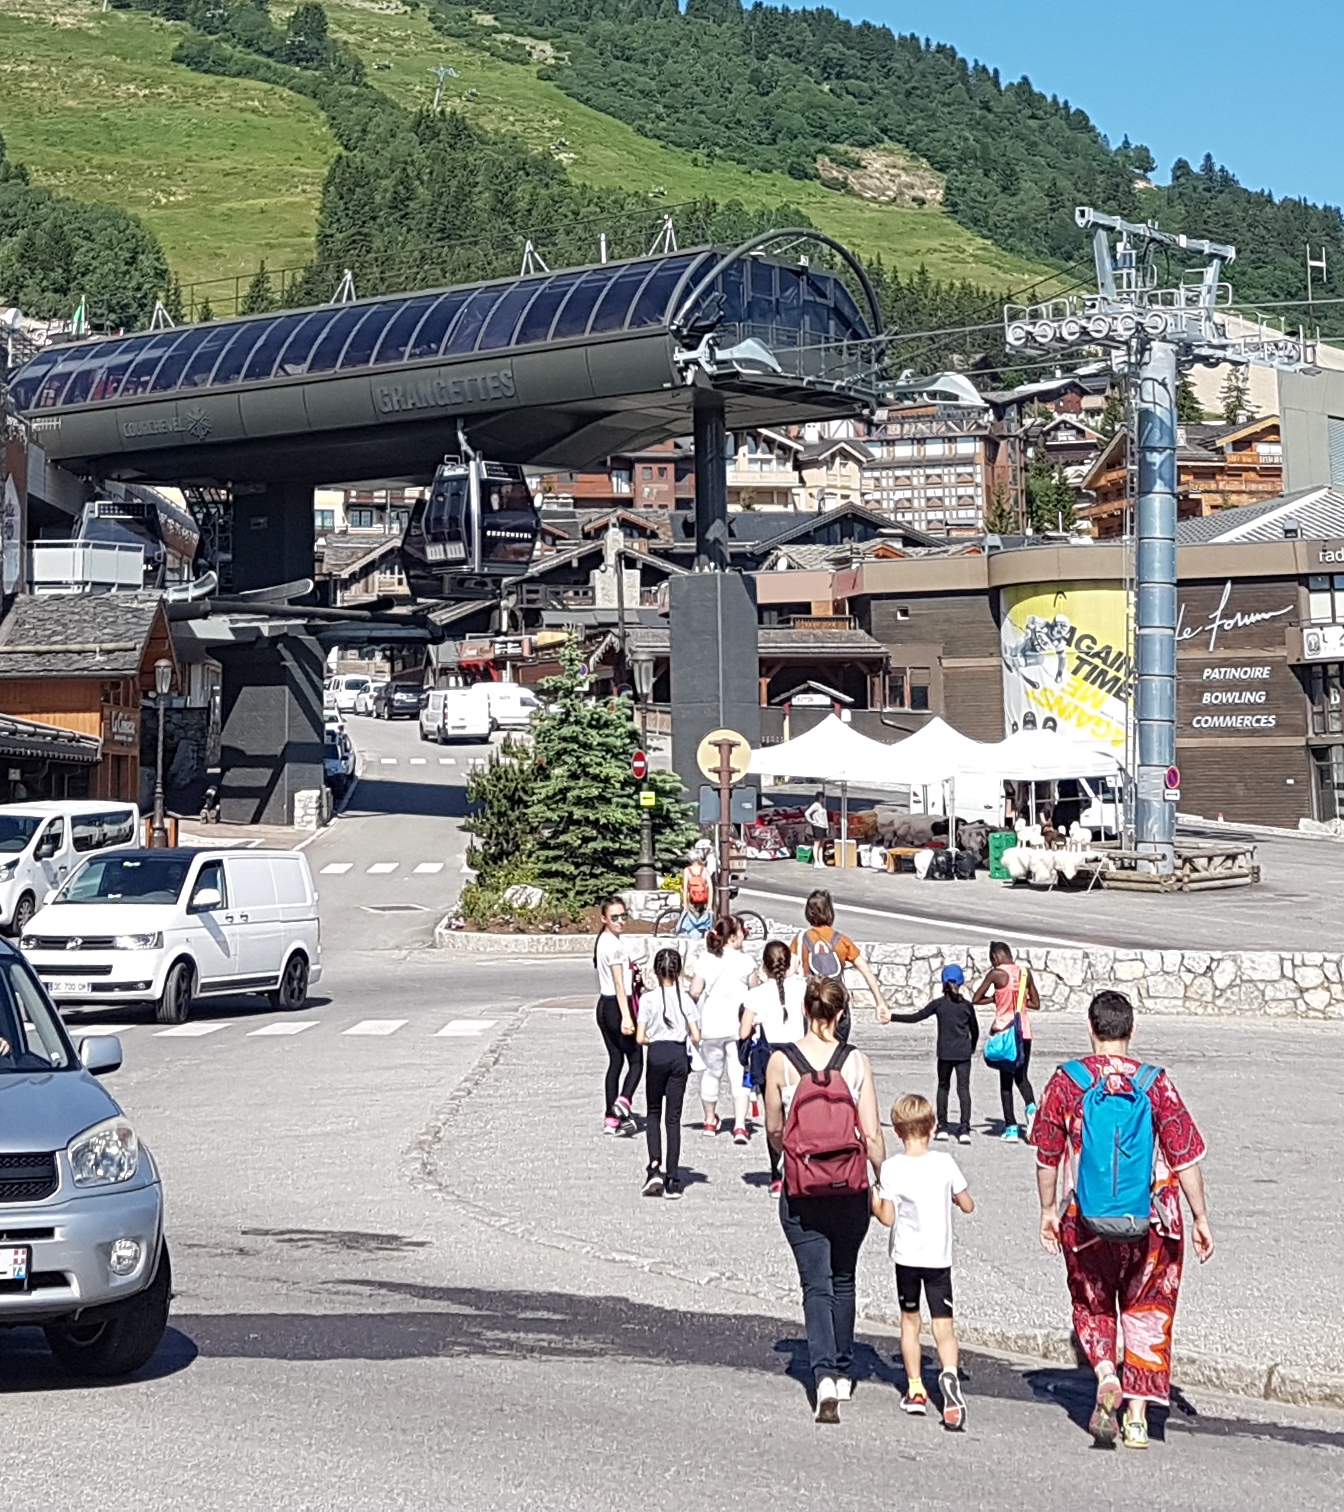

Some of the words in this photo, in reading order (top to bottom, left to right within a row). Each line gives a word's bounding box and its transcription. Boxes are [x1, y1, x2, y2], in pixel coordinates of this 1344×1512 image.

[377, 369, 516, 414] GRANGETTES
[1202, 666, 1272, 680] PATINOIRE
[1202, 691, 1266, 704] BOWLING
[1192, 715, 1277, 728] COMMERCES
